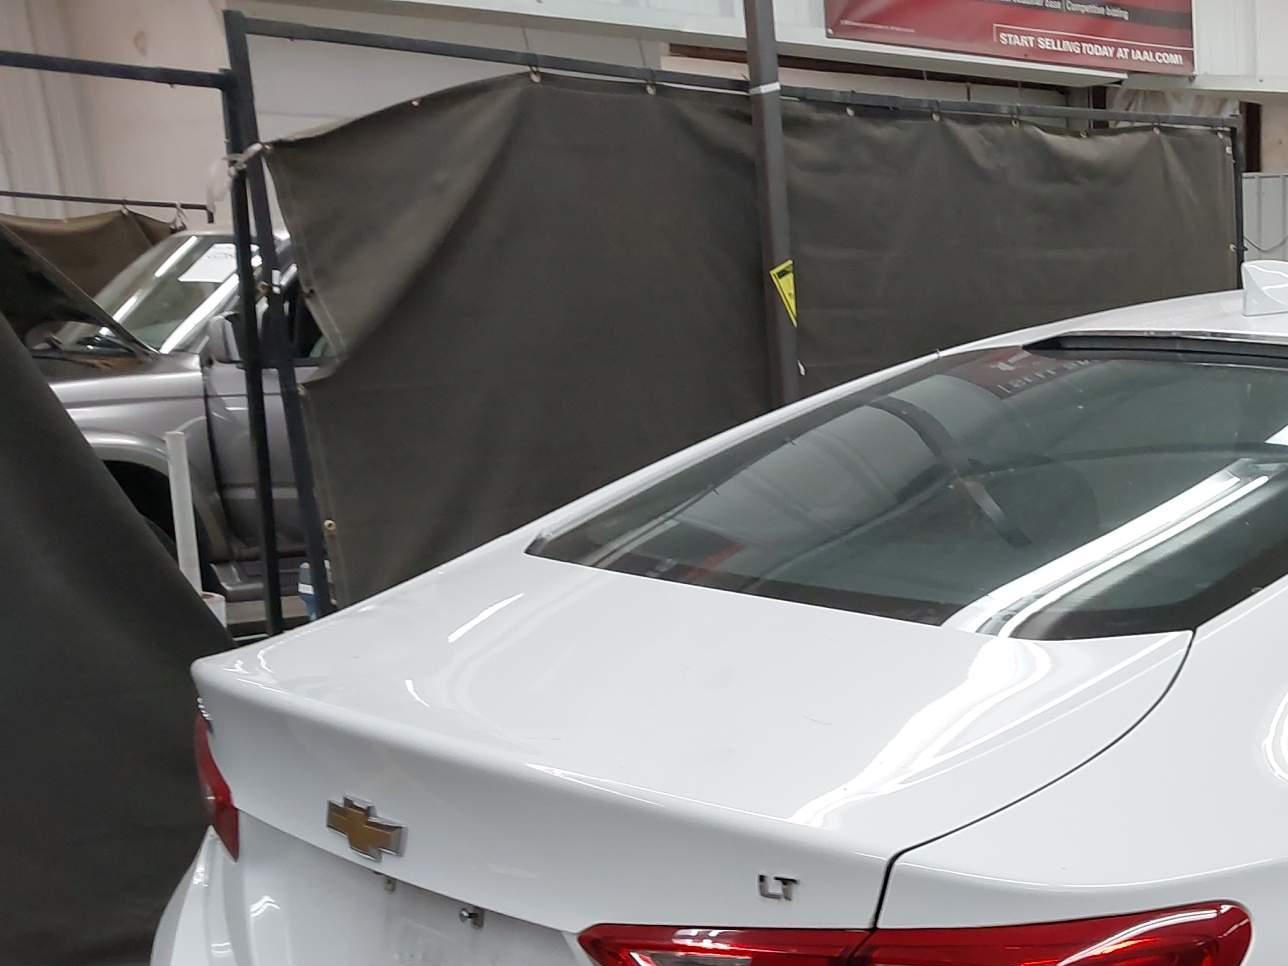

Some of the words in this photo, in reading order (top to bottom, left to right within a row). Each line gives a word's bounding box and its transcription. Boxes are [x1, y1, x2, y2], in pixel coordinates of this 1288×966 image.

[1000, 32, 1034, 47] START
[1037, 36, 1081, 54] SELLING
[1081, 42, 1115, 57] TODAY
[1116, 48, 1130, 59] AT
[759, 874, 799, 901] LT
